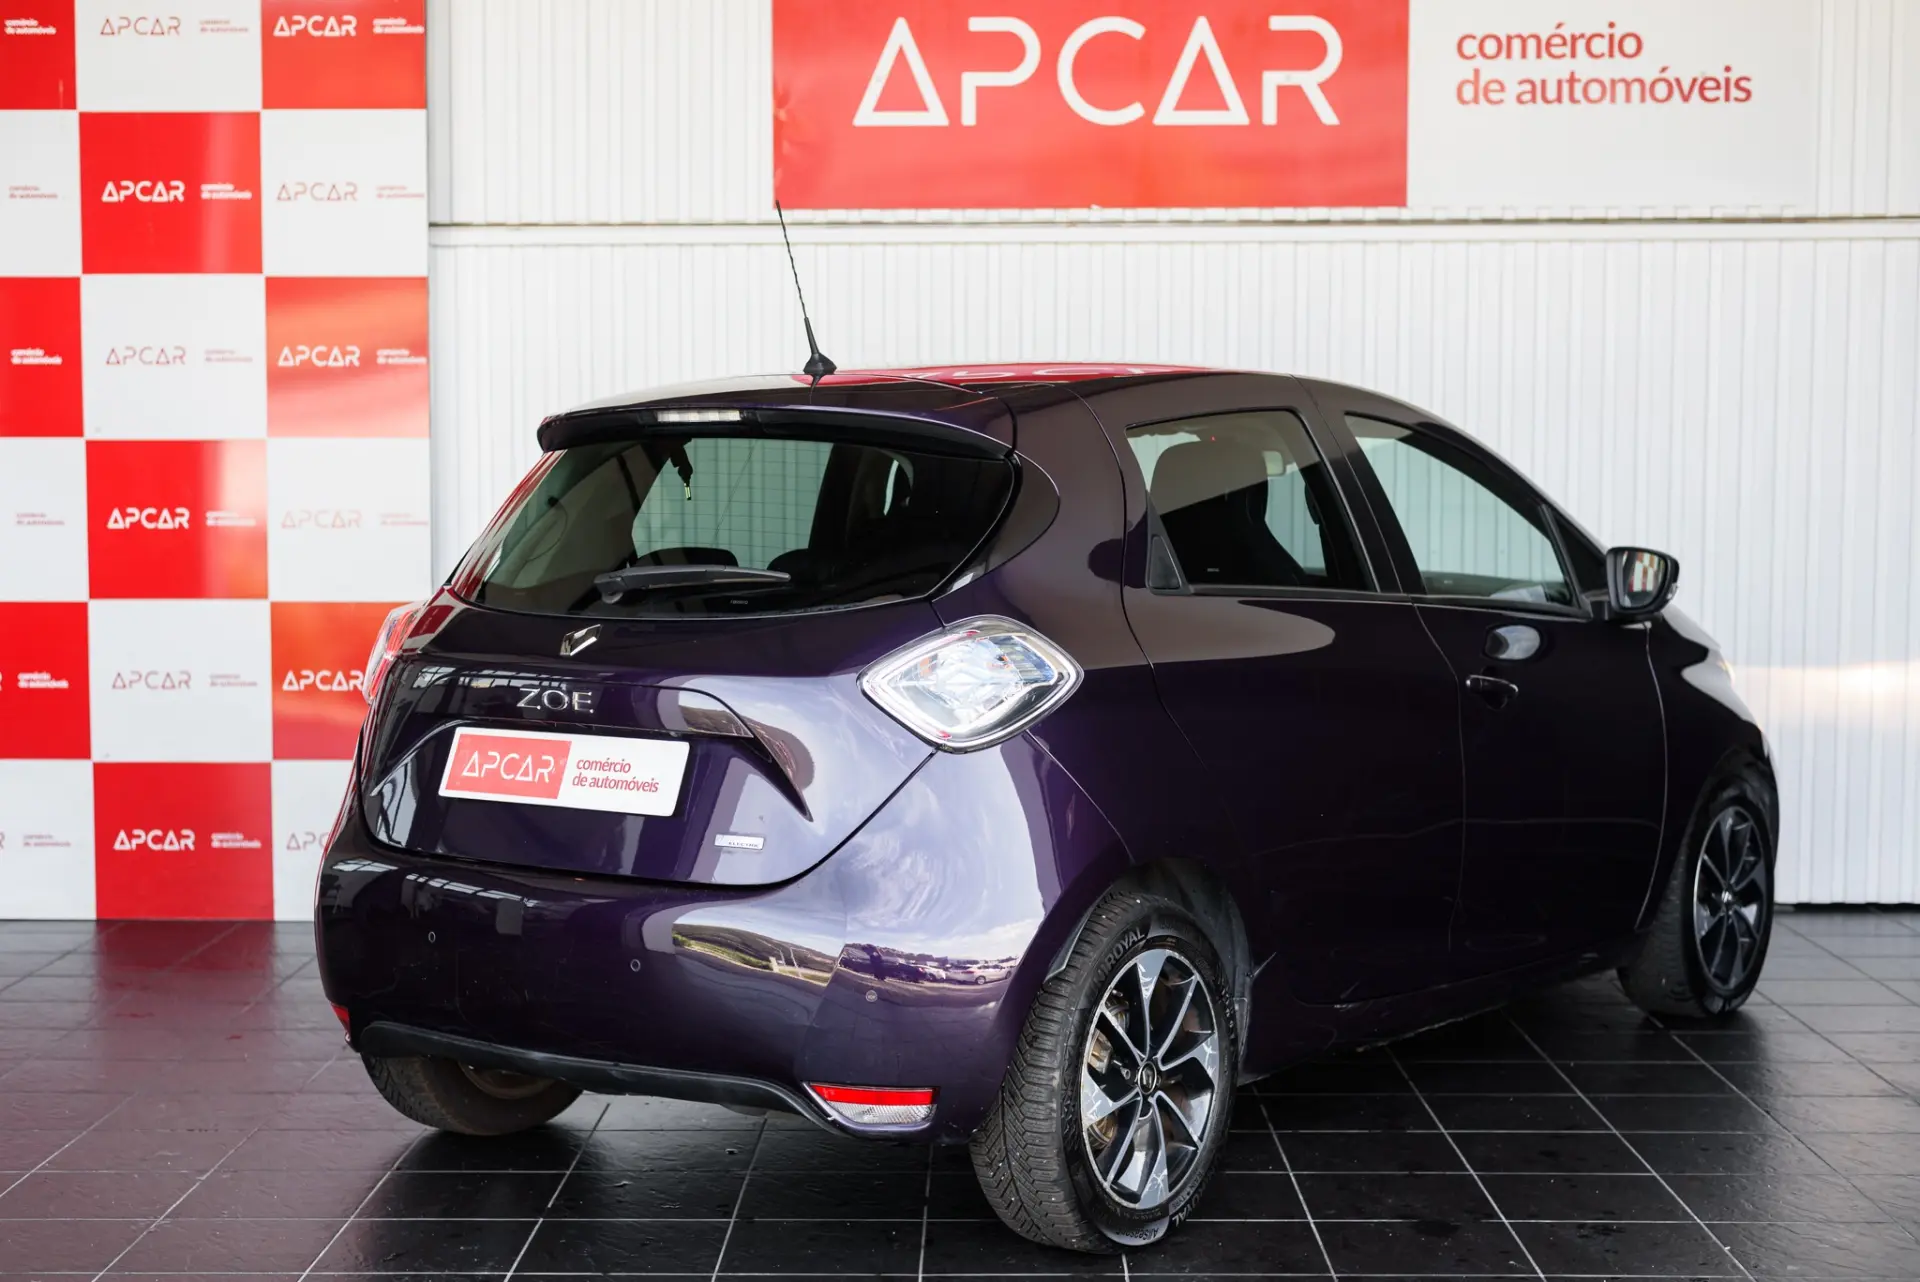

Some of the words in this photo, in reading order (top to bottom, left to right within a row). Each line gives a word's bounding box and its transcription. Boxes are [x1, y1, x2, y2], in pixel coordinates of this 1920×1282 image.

[100, 17, 181, 36] APCAR
[273, 15, 357, 37] APCAR
[1456, 21, 1644, 61] comércio
[852, 15, 1343, 127] APCAR
[1456, 67, 1507, 105] de
[1515, 65, 1753, 105] automóveis
[101, 180, 186, 203] APCAR
[276, 182, 358, 202] APCAR
[106, 346, 186, 366] APCAR
[277, 345, 361, 367] APCAR
[106, 507, 191, 530] APCAR
[111, 670, 192, 690] APCAR
[282, 670, 363, 692] APCAR
[461, 751, 555, 784] APCAR
[576, 757, 631, 774] comércio
[572, 772, 588, 787] de
[588, 774, 660, 793] automóveis
[113, 828, 196, 852] APCAR
